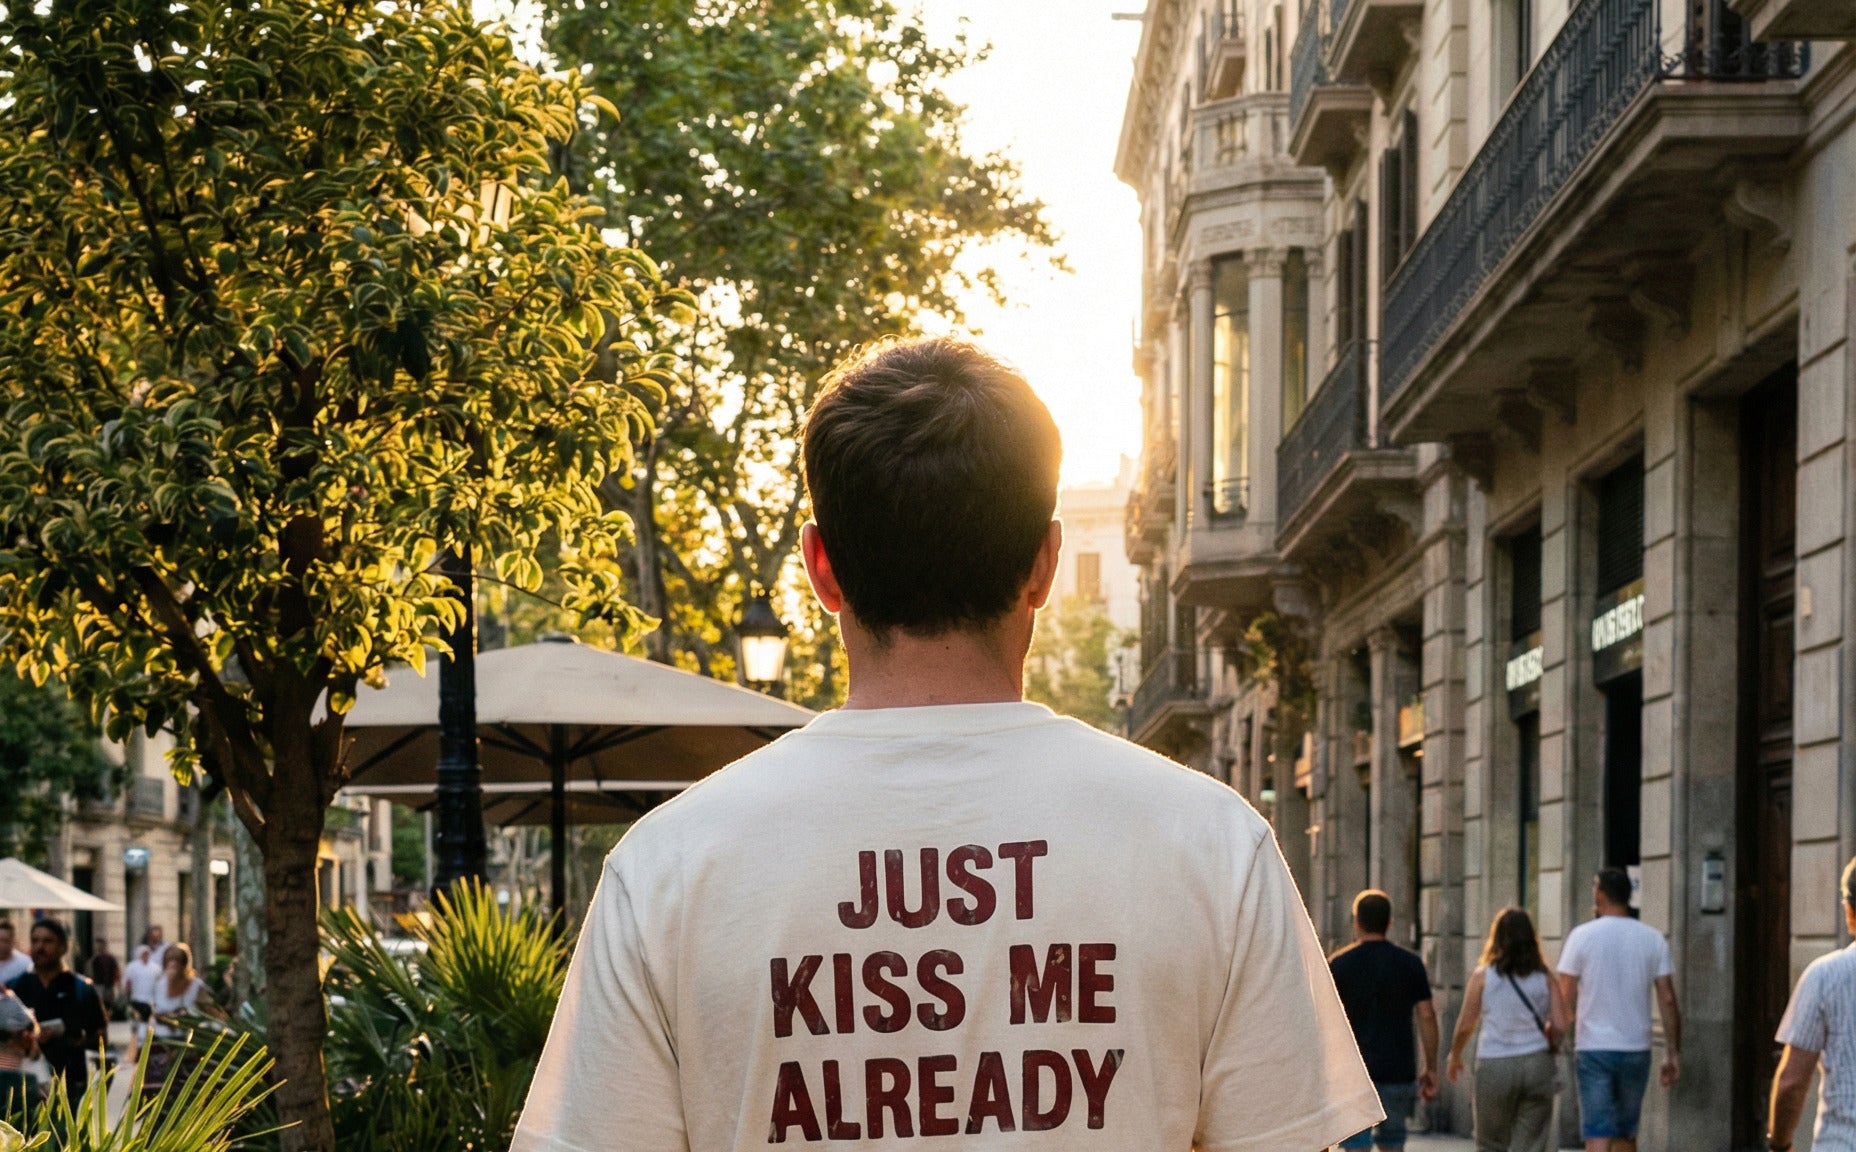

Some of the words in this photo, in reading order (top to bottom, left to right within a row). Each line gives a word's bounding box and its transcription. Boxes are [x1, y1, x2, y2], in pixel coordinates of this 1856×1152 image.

[838, 840, 1048, 929] JUST
[770, 949, 966, 1038] KISS
[1009, 943, 1117, 1025] ME
[767, 1048, 1125, 1143] ALREADY
